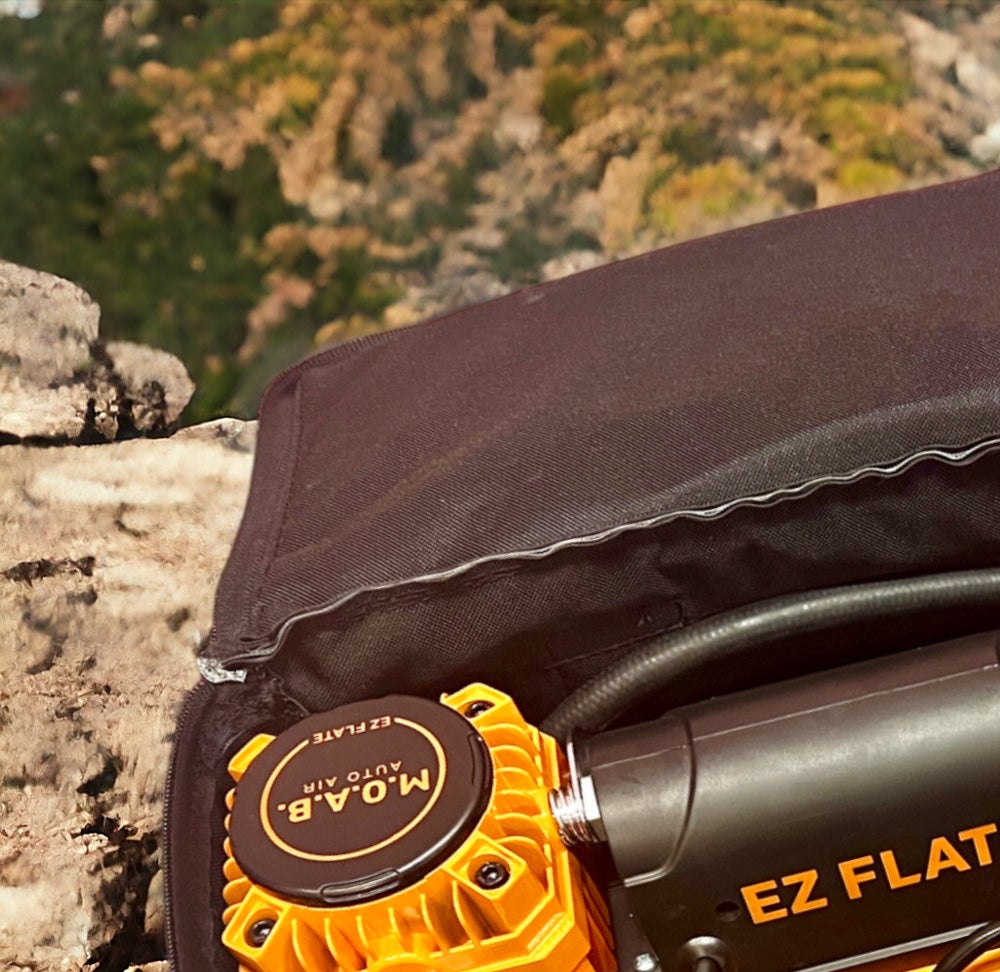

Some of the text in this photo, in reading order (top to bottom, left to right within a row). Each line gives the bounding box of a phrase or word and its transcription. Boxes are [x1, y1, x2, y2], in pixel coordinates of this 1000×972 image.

[313, 716, 391, 744] EZ FLATE
[277, 768, 430, 823] M.O.A.B.
[303, 760, 402, 794] AUTO AIR
[740, 869, 828, 925] EZ
